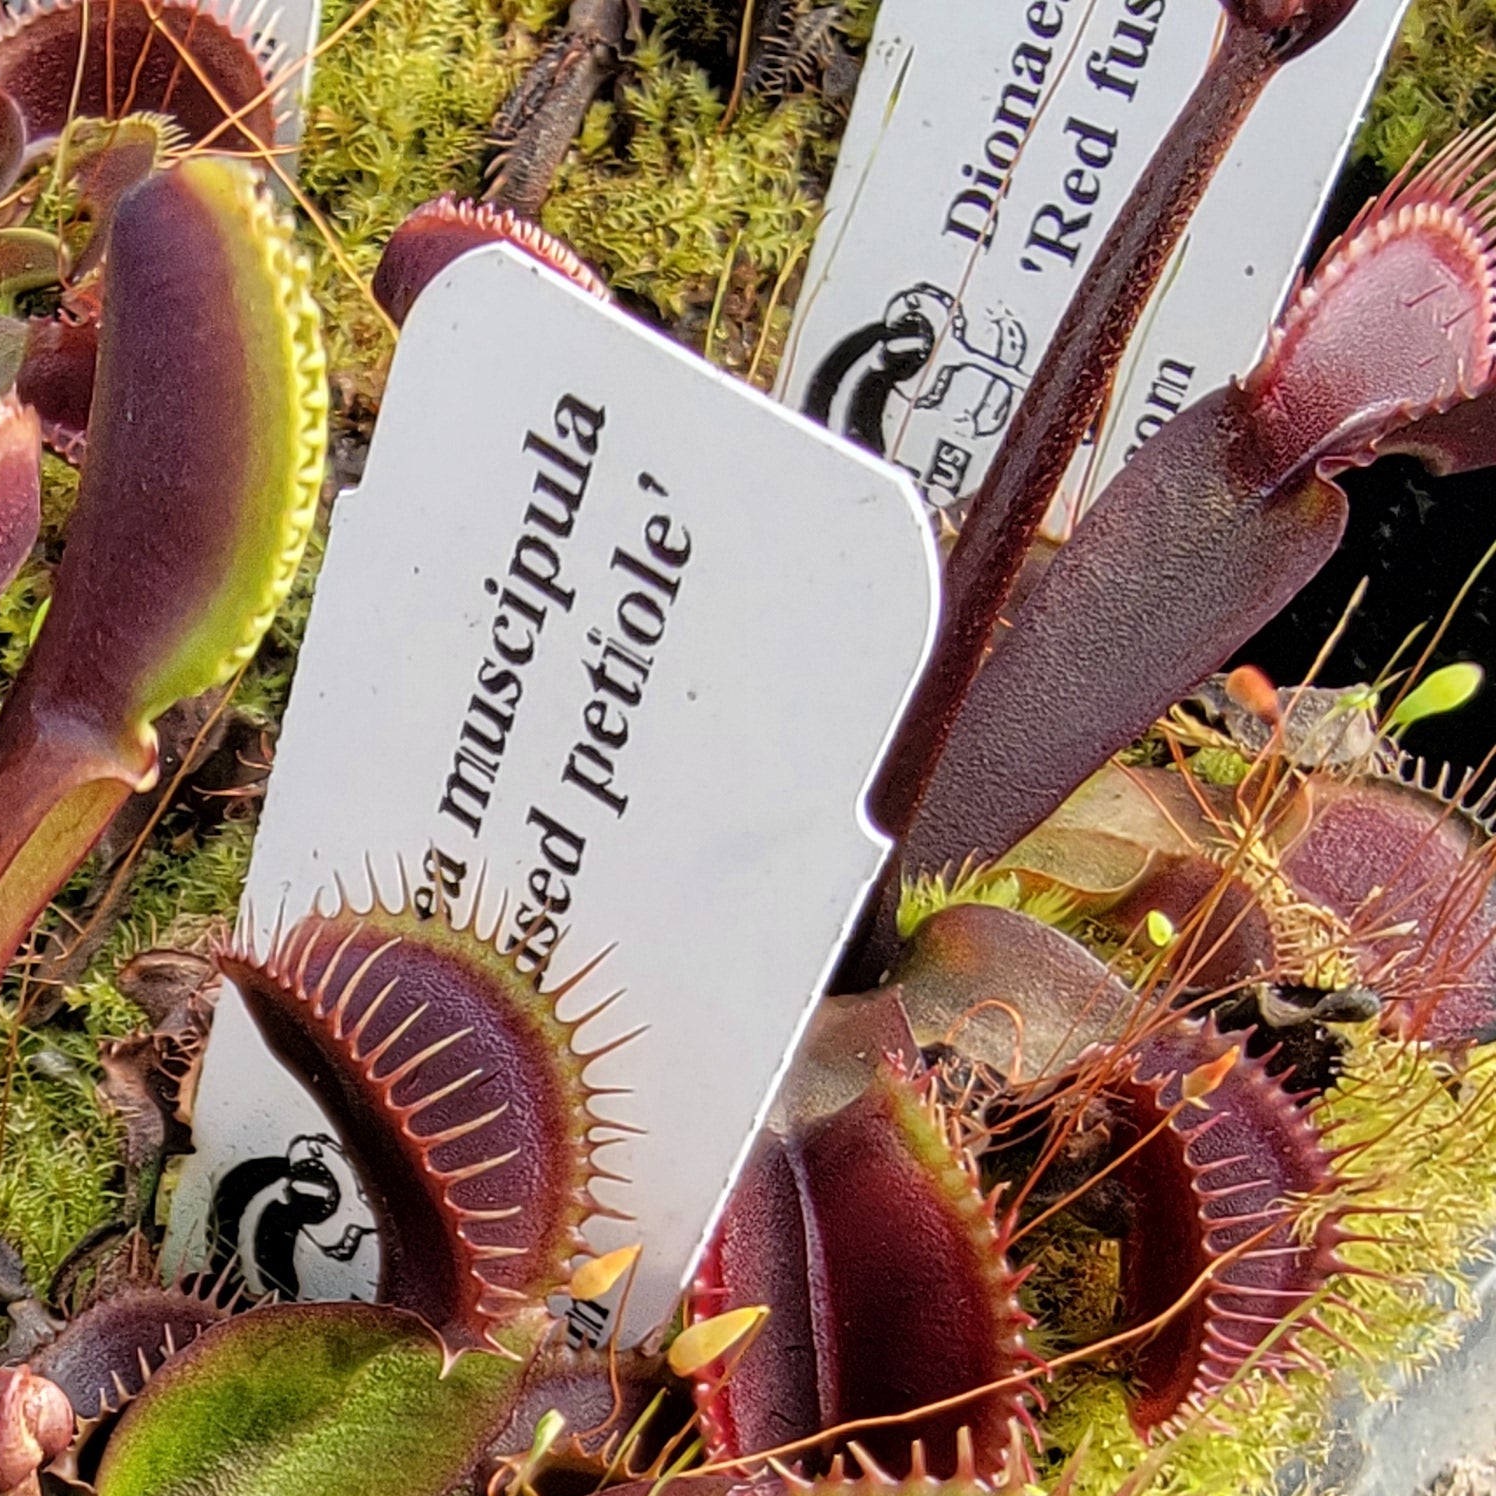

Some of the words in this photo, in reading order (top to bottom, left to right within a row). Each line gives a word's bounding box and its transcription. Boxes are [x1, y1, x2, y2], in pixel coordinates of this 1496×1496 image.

[942, 0, 1069, 254] Dionae
[1020, 116, 1119, 272] 'Red
[438, 393, 605, 838] muscipula
[561, 471, 692, 819] petiole'
